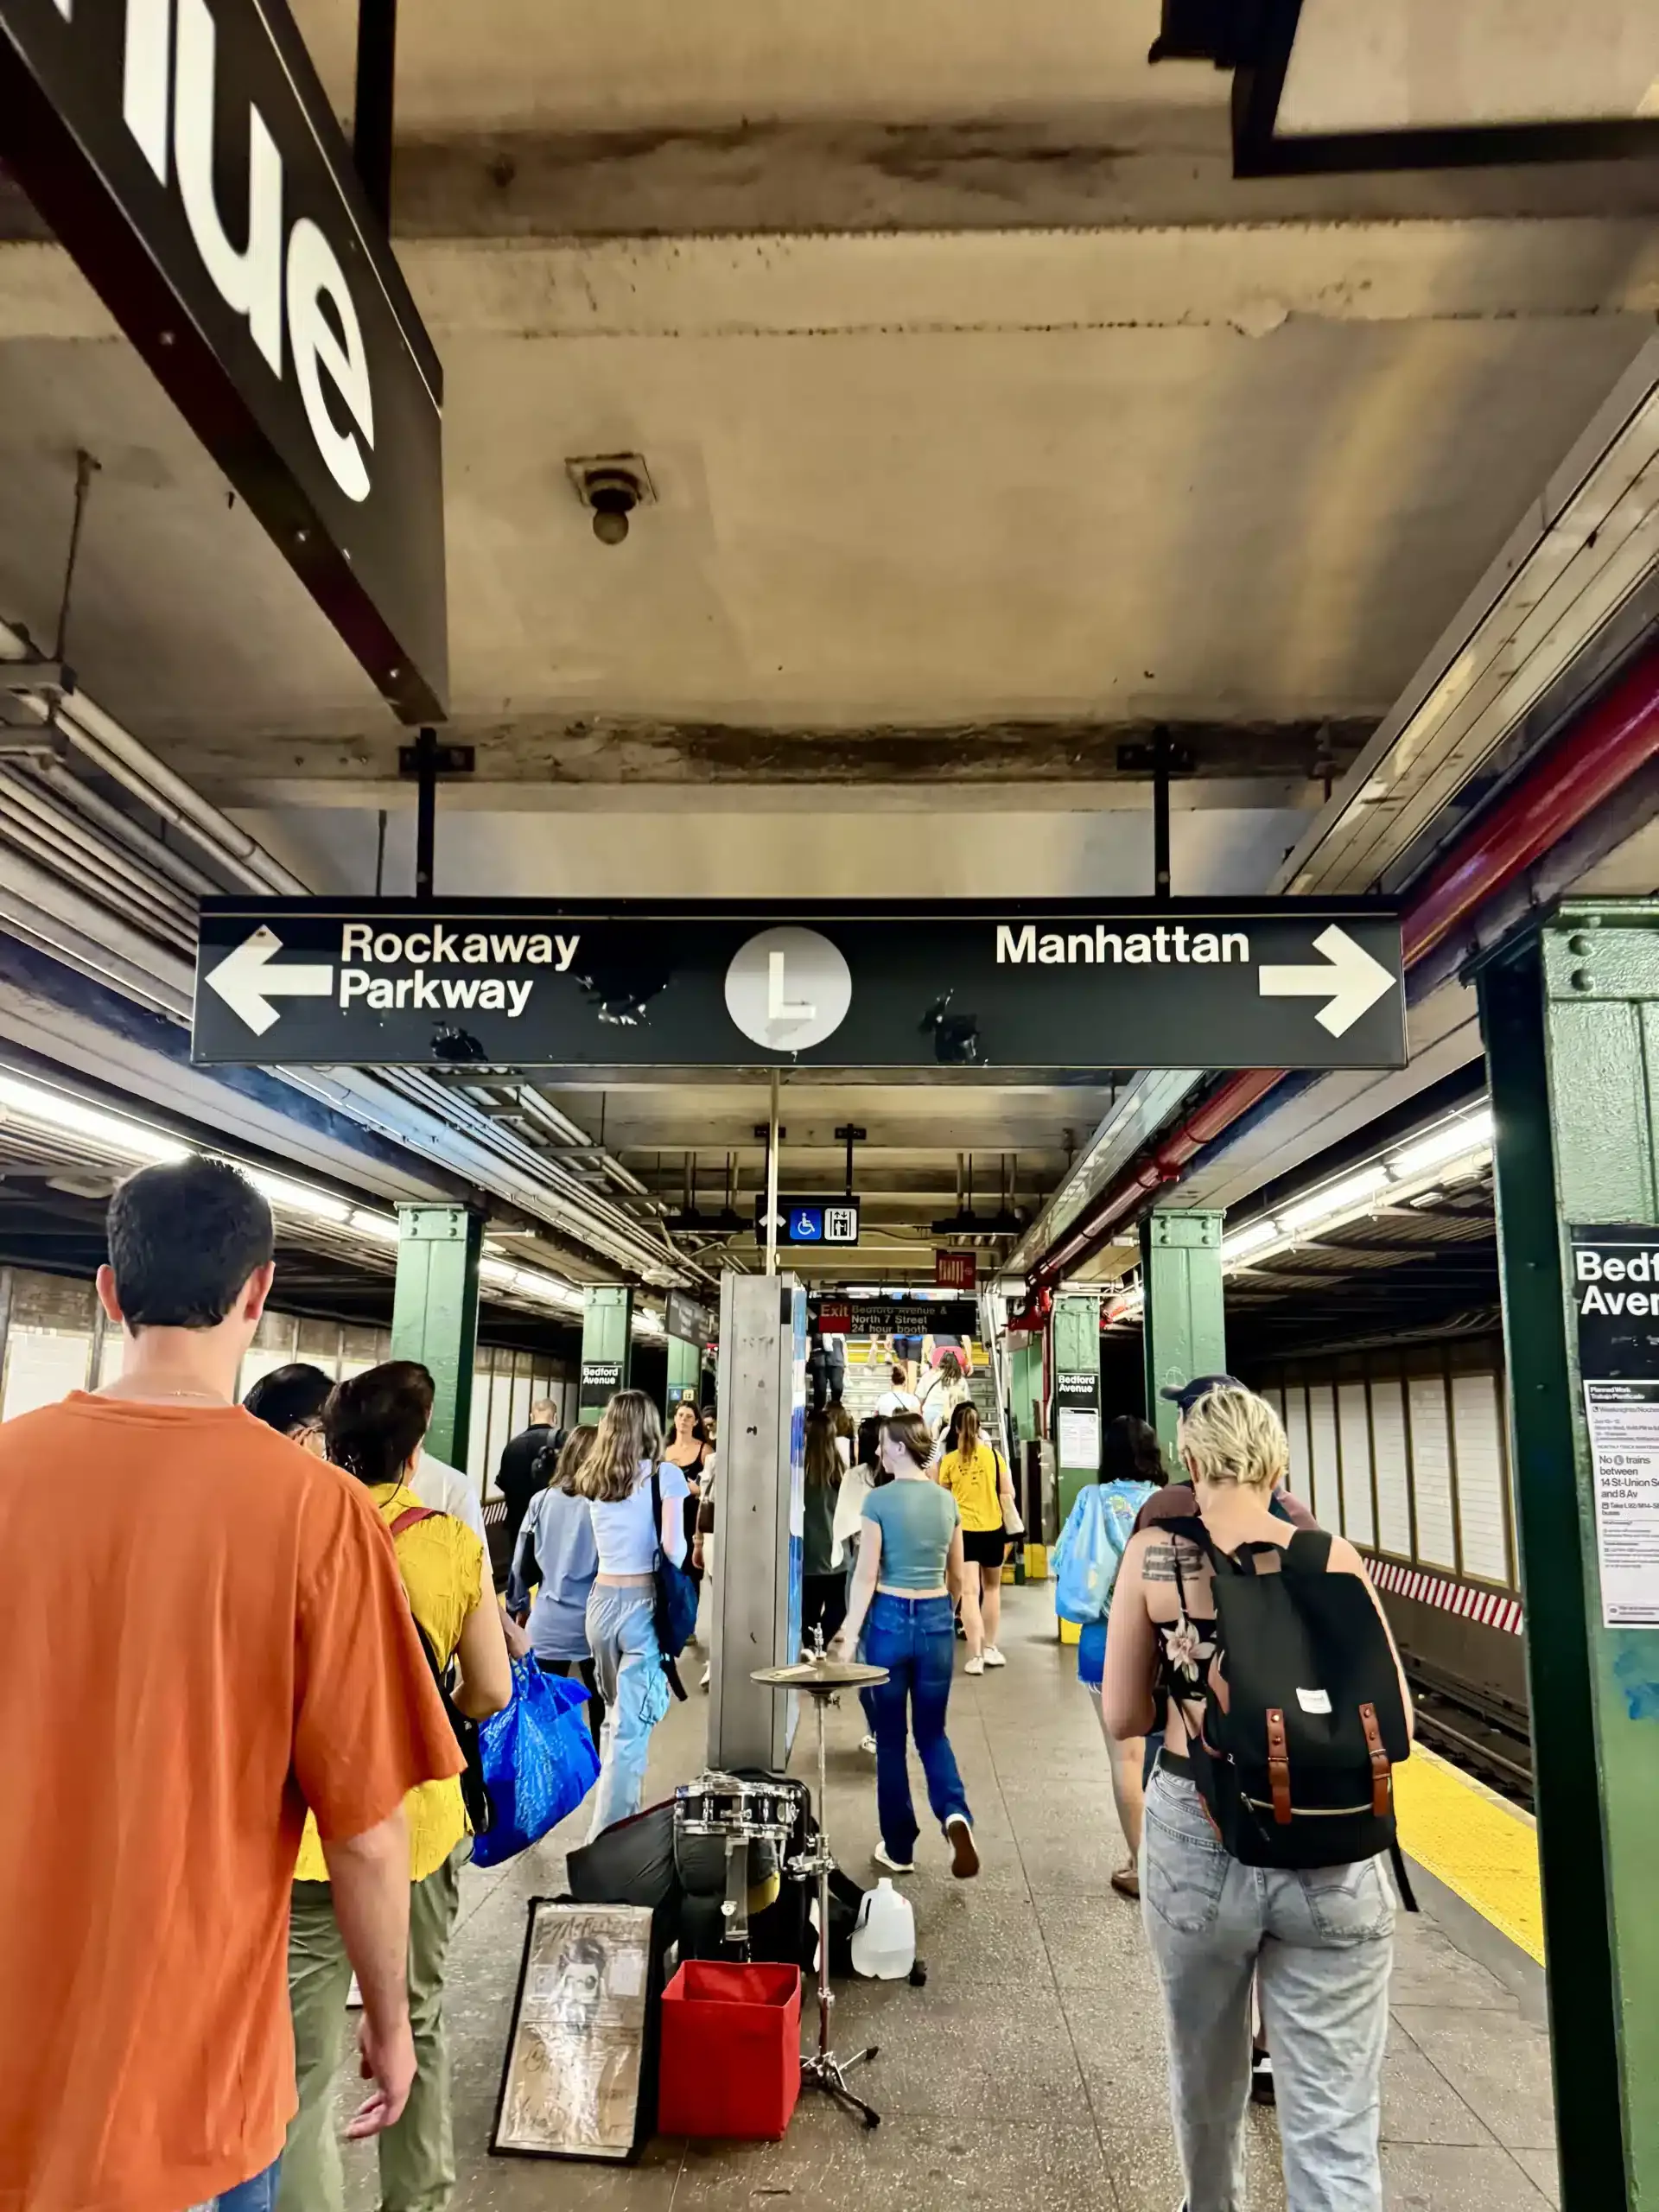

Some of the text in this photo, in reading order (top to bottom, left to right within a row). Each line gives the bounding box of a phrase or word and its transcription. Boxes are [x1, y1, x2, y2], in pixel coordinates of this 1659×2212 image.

[340, 924, 580, 972] Rockaway
[996, 925, 1249, 963] Manhattan
[769, 951, 816, 1020] L
[340, 969, 533, 1018] Parkway
[821, 1305, 849, 1318] Exit
[851, 1315, 881, 1324] North
[895, 1315, 928, 1324] Street
[851, 1324, 928, 1333] 24 hour booth
[582, 1368, 619, 1376] Bedford
[1058, 1376, 1096, 1384] Bedford
[1058, 1384, 1093, 1393] Avenue
[1599, 1455, 1612, 1464] No
[1626, 1454, 1651, 1464] trains
[1600, 1466, 1638, 1476] between
[1601, 1478, 1611, 1486] 14
[1651, 1478, 1659, 1487] S
